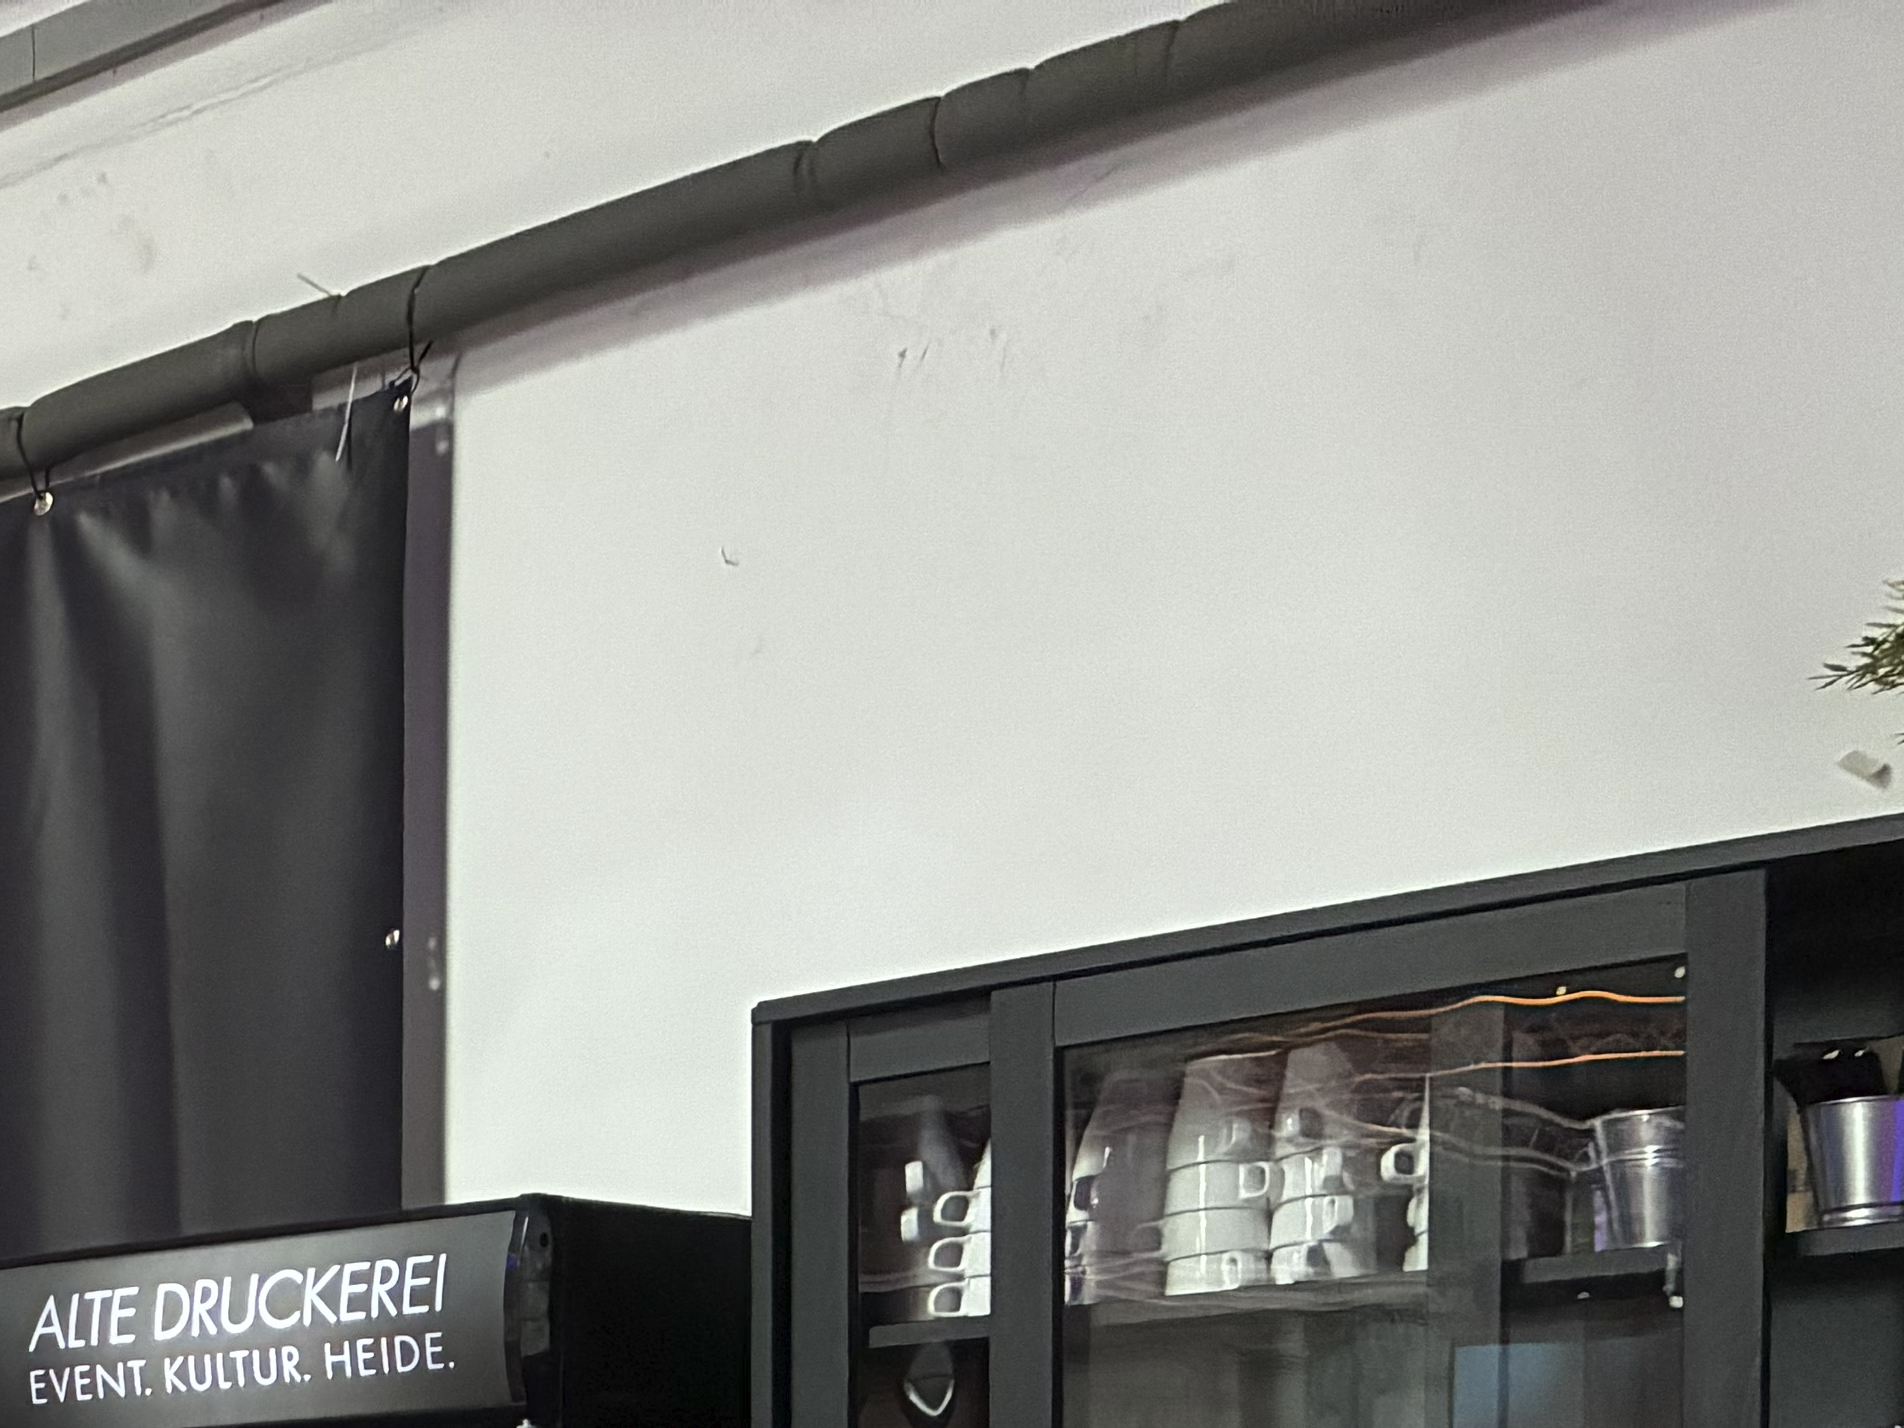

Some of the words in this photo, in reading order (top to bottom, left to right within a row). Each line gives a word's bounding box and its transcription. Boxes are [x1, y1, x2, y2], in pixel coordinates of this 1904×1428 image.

[28, 1286, 140, 1353] ALTE
[153, 1253, 448, 1341] DRUCKEREI
[29, 1359, 153, 1405] EVENT.
[163, 1346, 312, 1395] KULTUR.
[324, 1332, 456, 1380] HEIDE.
